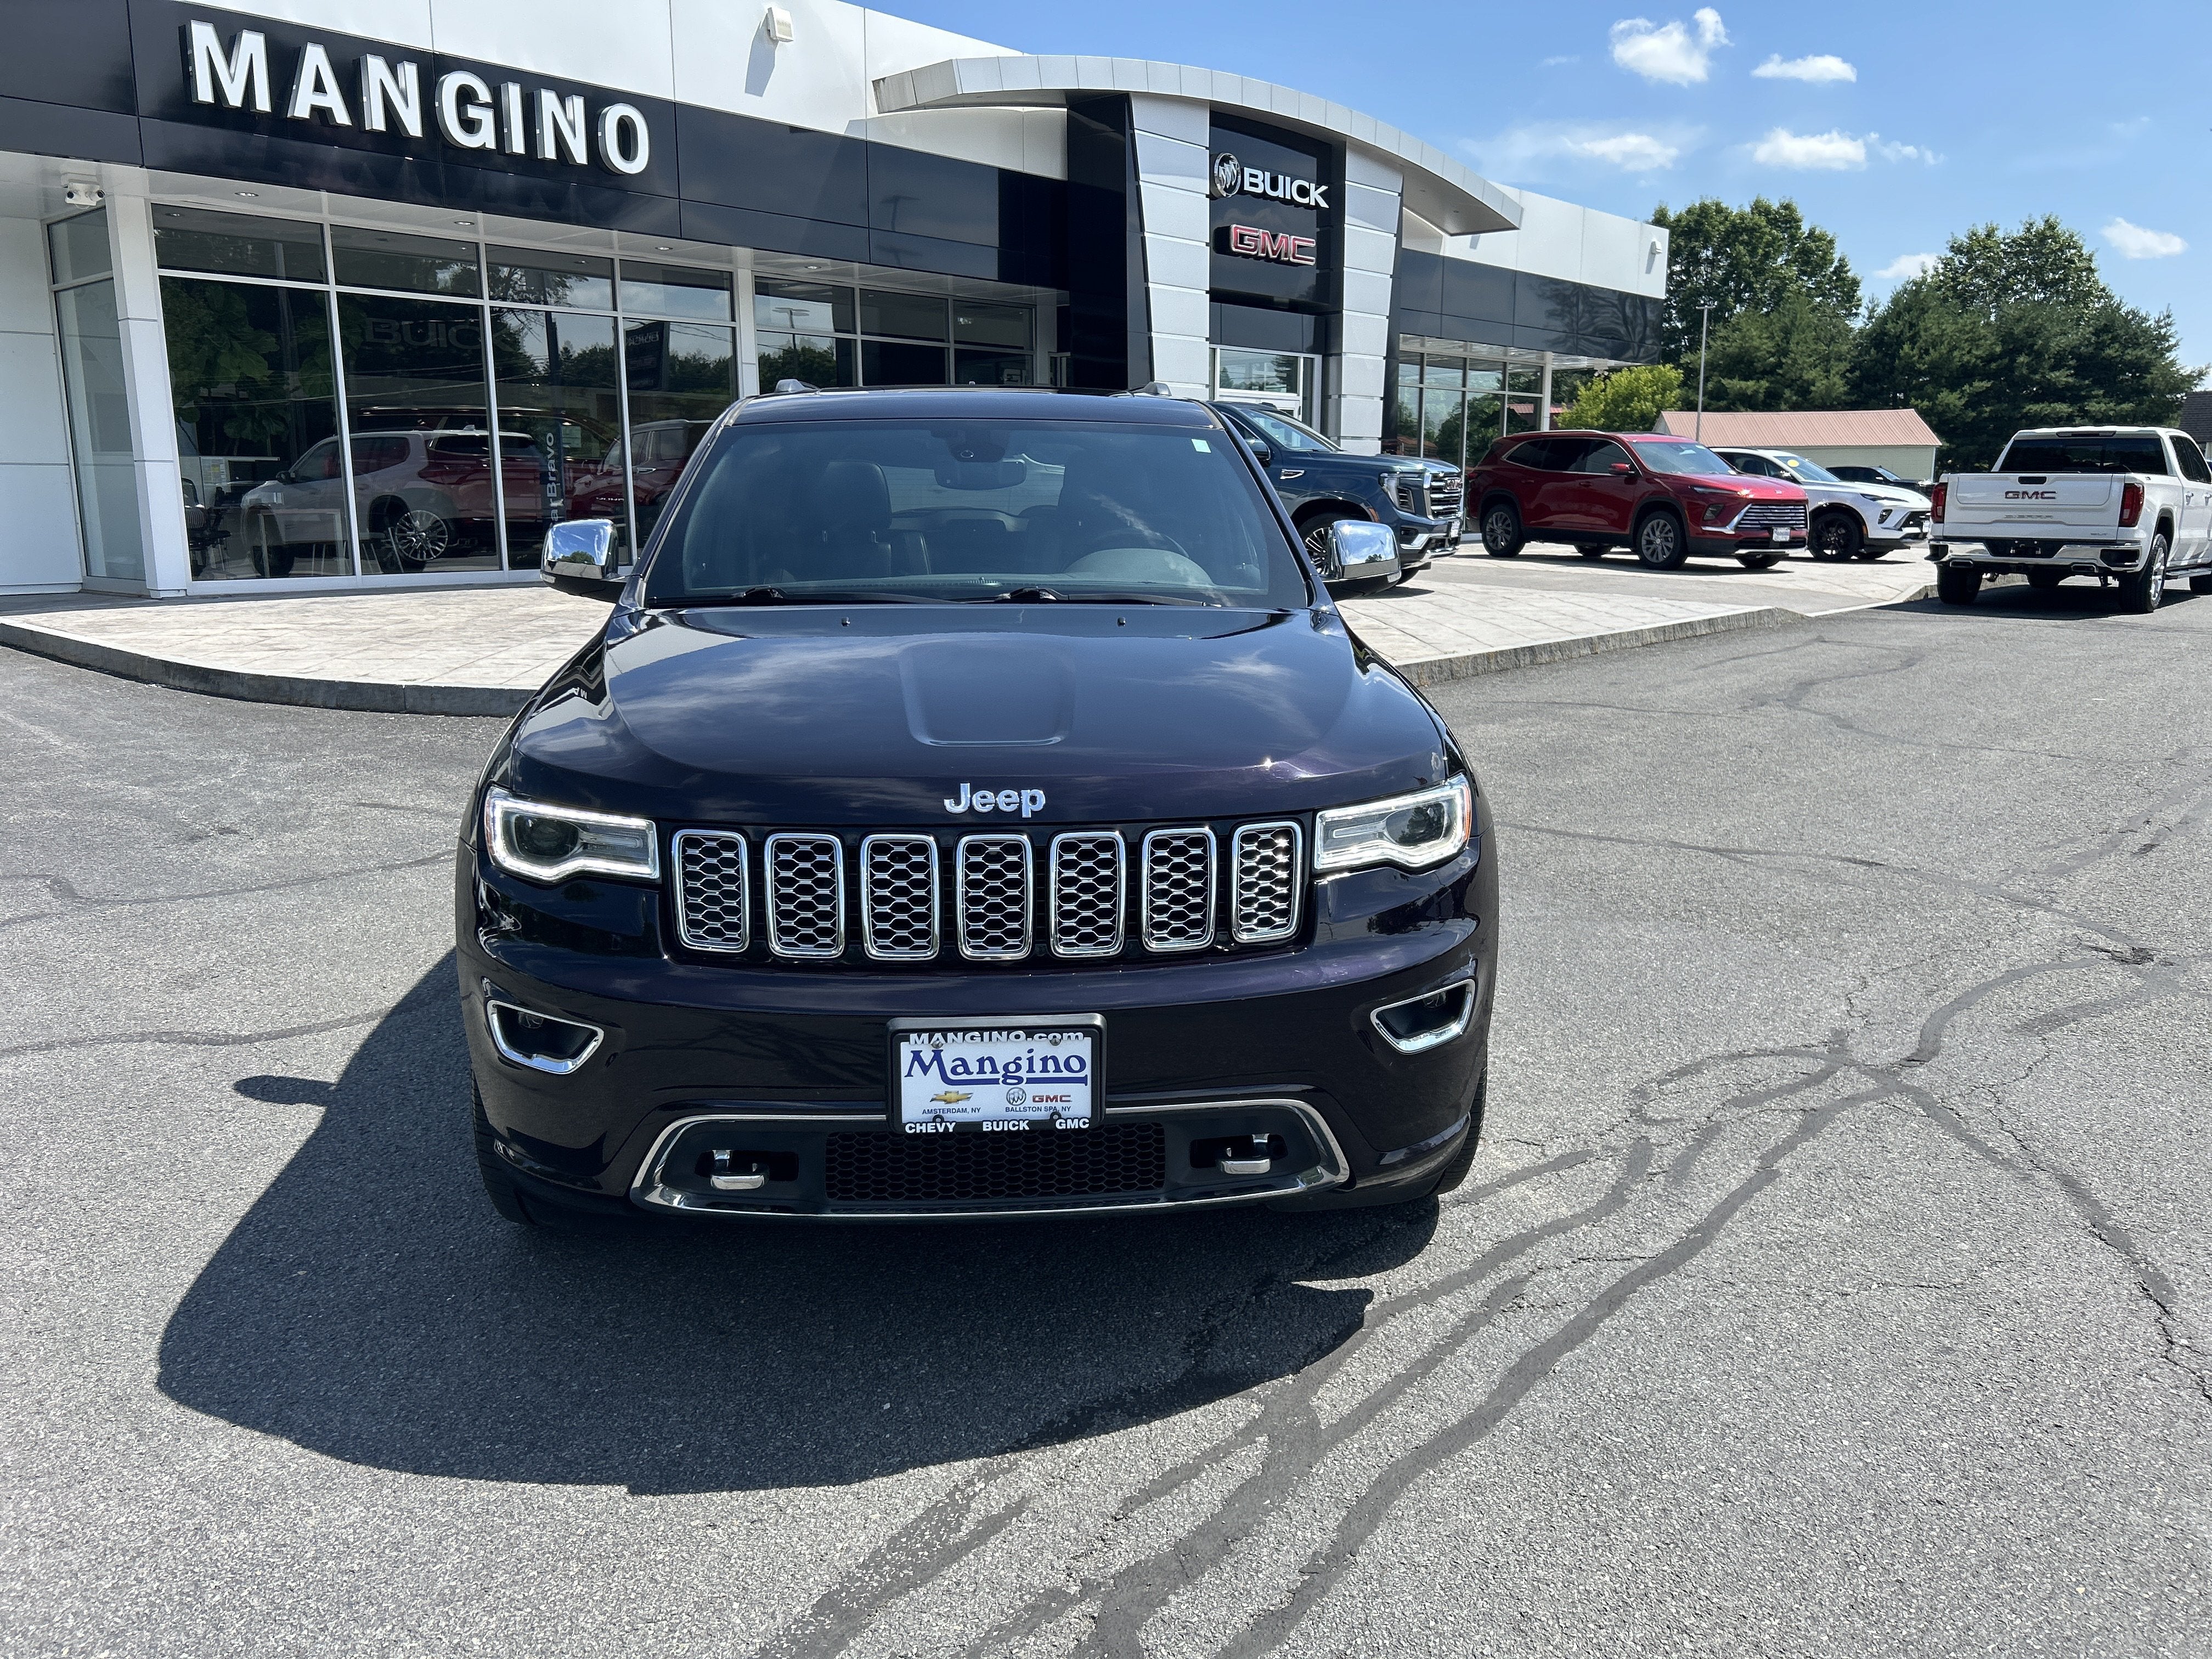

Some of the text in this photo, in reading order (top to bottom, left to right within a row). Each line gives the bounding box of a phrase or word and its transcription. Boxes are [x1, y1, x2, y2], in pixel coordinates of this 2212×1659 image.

[185, 20, 651, 176] MANGINO
[1244, 167, 1329, 208] BUICK
[1231, 224, 1316, 266] GMC
[546, 432, 560, 522] arBravo
[2005, 490, 2057, 500] GMC
[944, 782, 1046, 818] Jeep
[909, 1030, 1085, 1045] MANGINO.com
[904, 1048, 1088, 1086] Mangino
[1032, 1094, 1073, 1103] GMC
[905, 1118, 1090, 1133] CHEVY BUICK GMC
